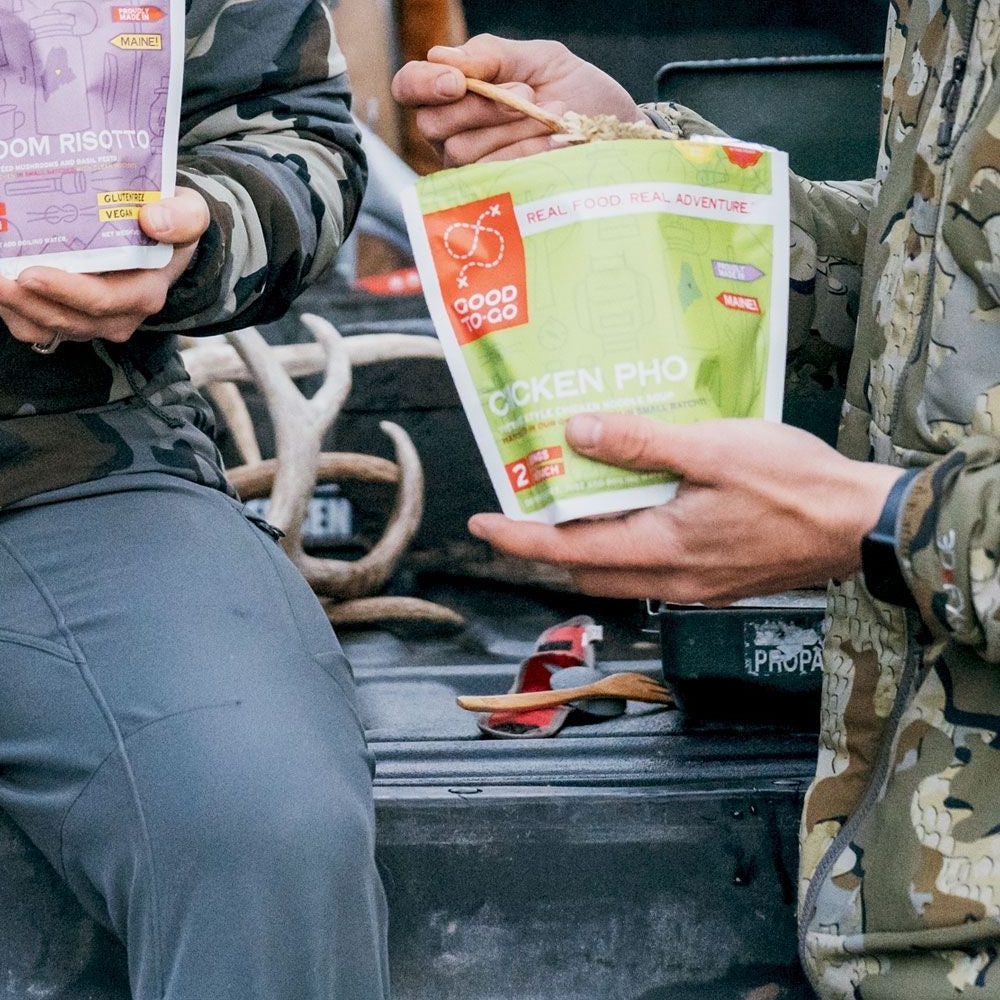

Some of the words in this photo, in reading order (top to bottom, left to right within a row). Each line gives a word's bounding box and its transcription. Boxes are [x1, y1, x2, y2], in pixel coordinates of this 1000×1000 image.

[120, 36, 159, 47] MAINE!
[60, 129, 150, 153] RISOTTO
[105, 209, 133, 219] VEGAN
[526, 204, 567, 224] REAL
[573, 194, 621, 212] FOOD
[630, 191, 671, 204] REAL
[454, 285, 518, 315] GOOD
[461, 303, 518, 332] TO-GO
[614, 354, 689, 391] PHO
[511, 462, 529, 488] 2
